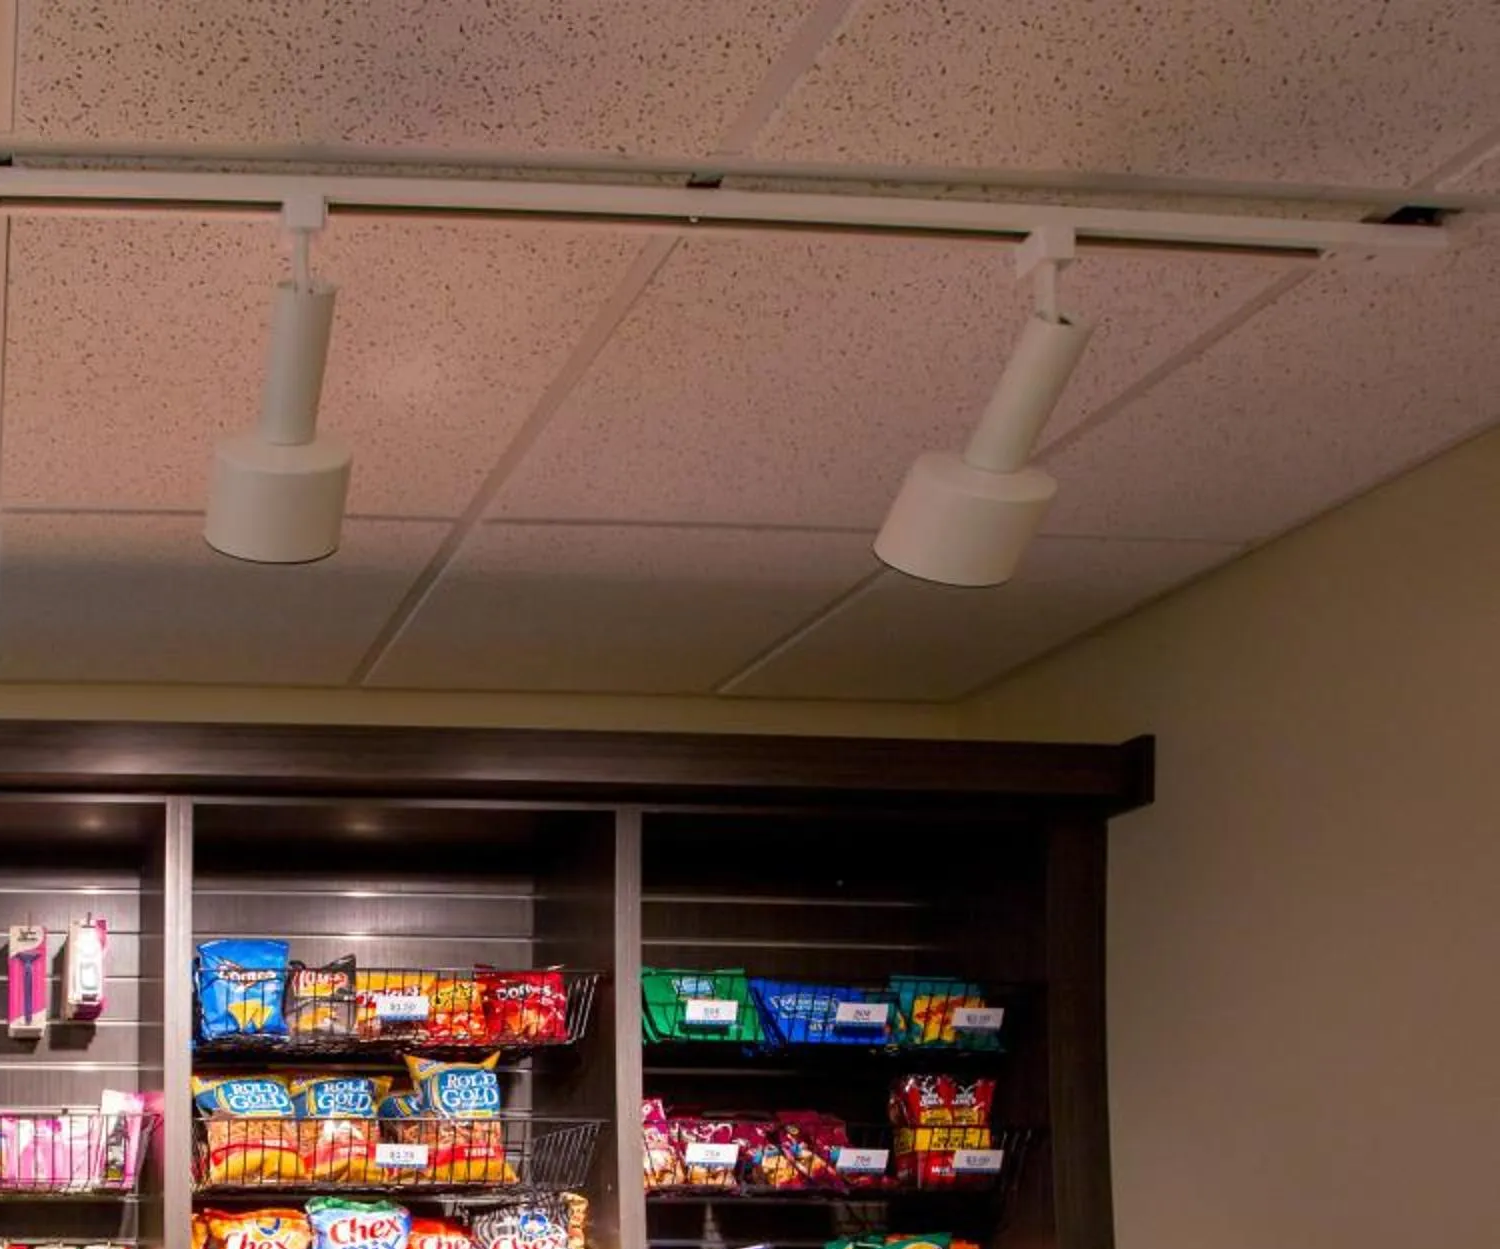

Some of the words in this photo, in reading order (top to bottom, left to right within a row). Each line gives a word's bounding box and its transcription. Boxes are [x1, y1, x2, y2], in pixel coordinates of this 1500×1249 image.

[230, 1094, 289, 1109] GOLD
[318, 1092, 372, 1110] GOLD
[442, 1087, 499, 1107] GOLD
[328, 1216, 402, 1246] Chex
